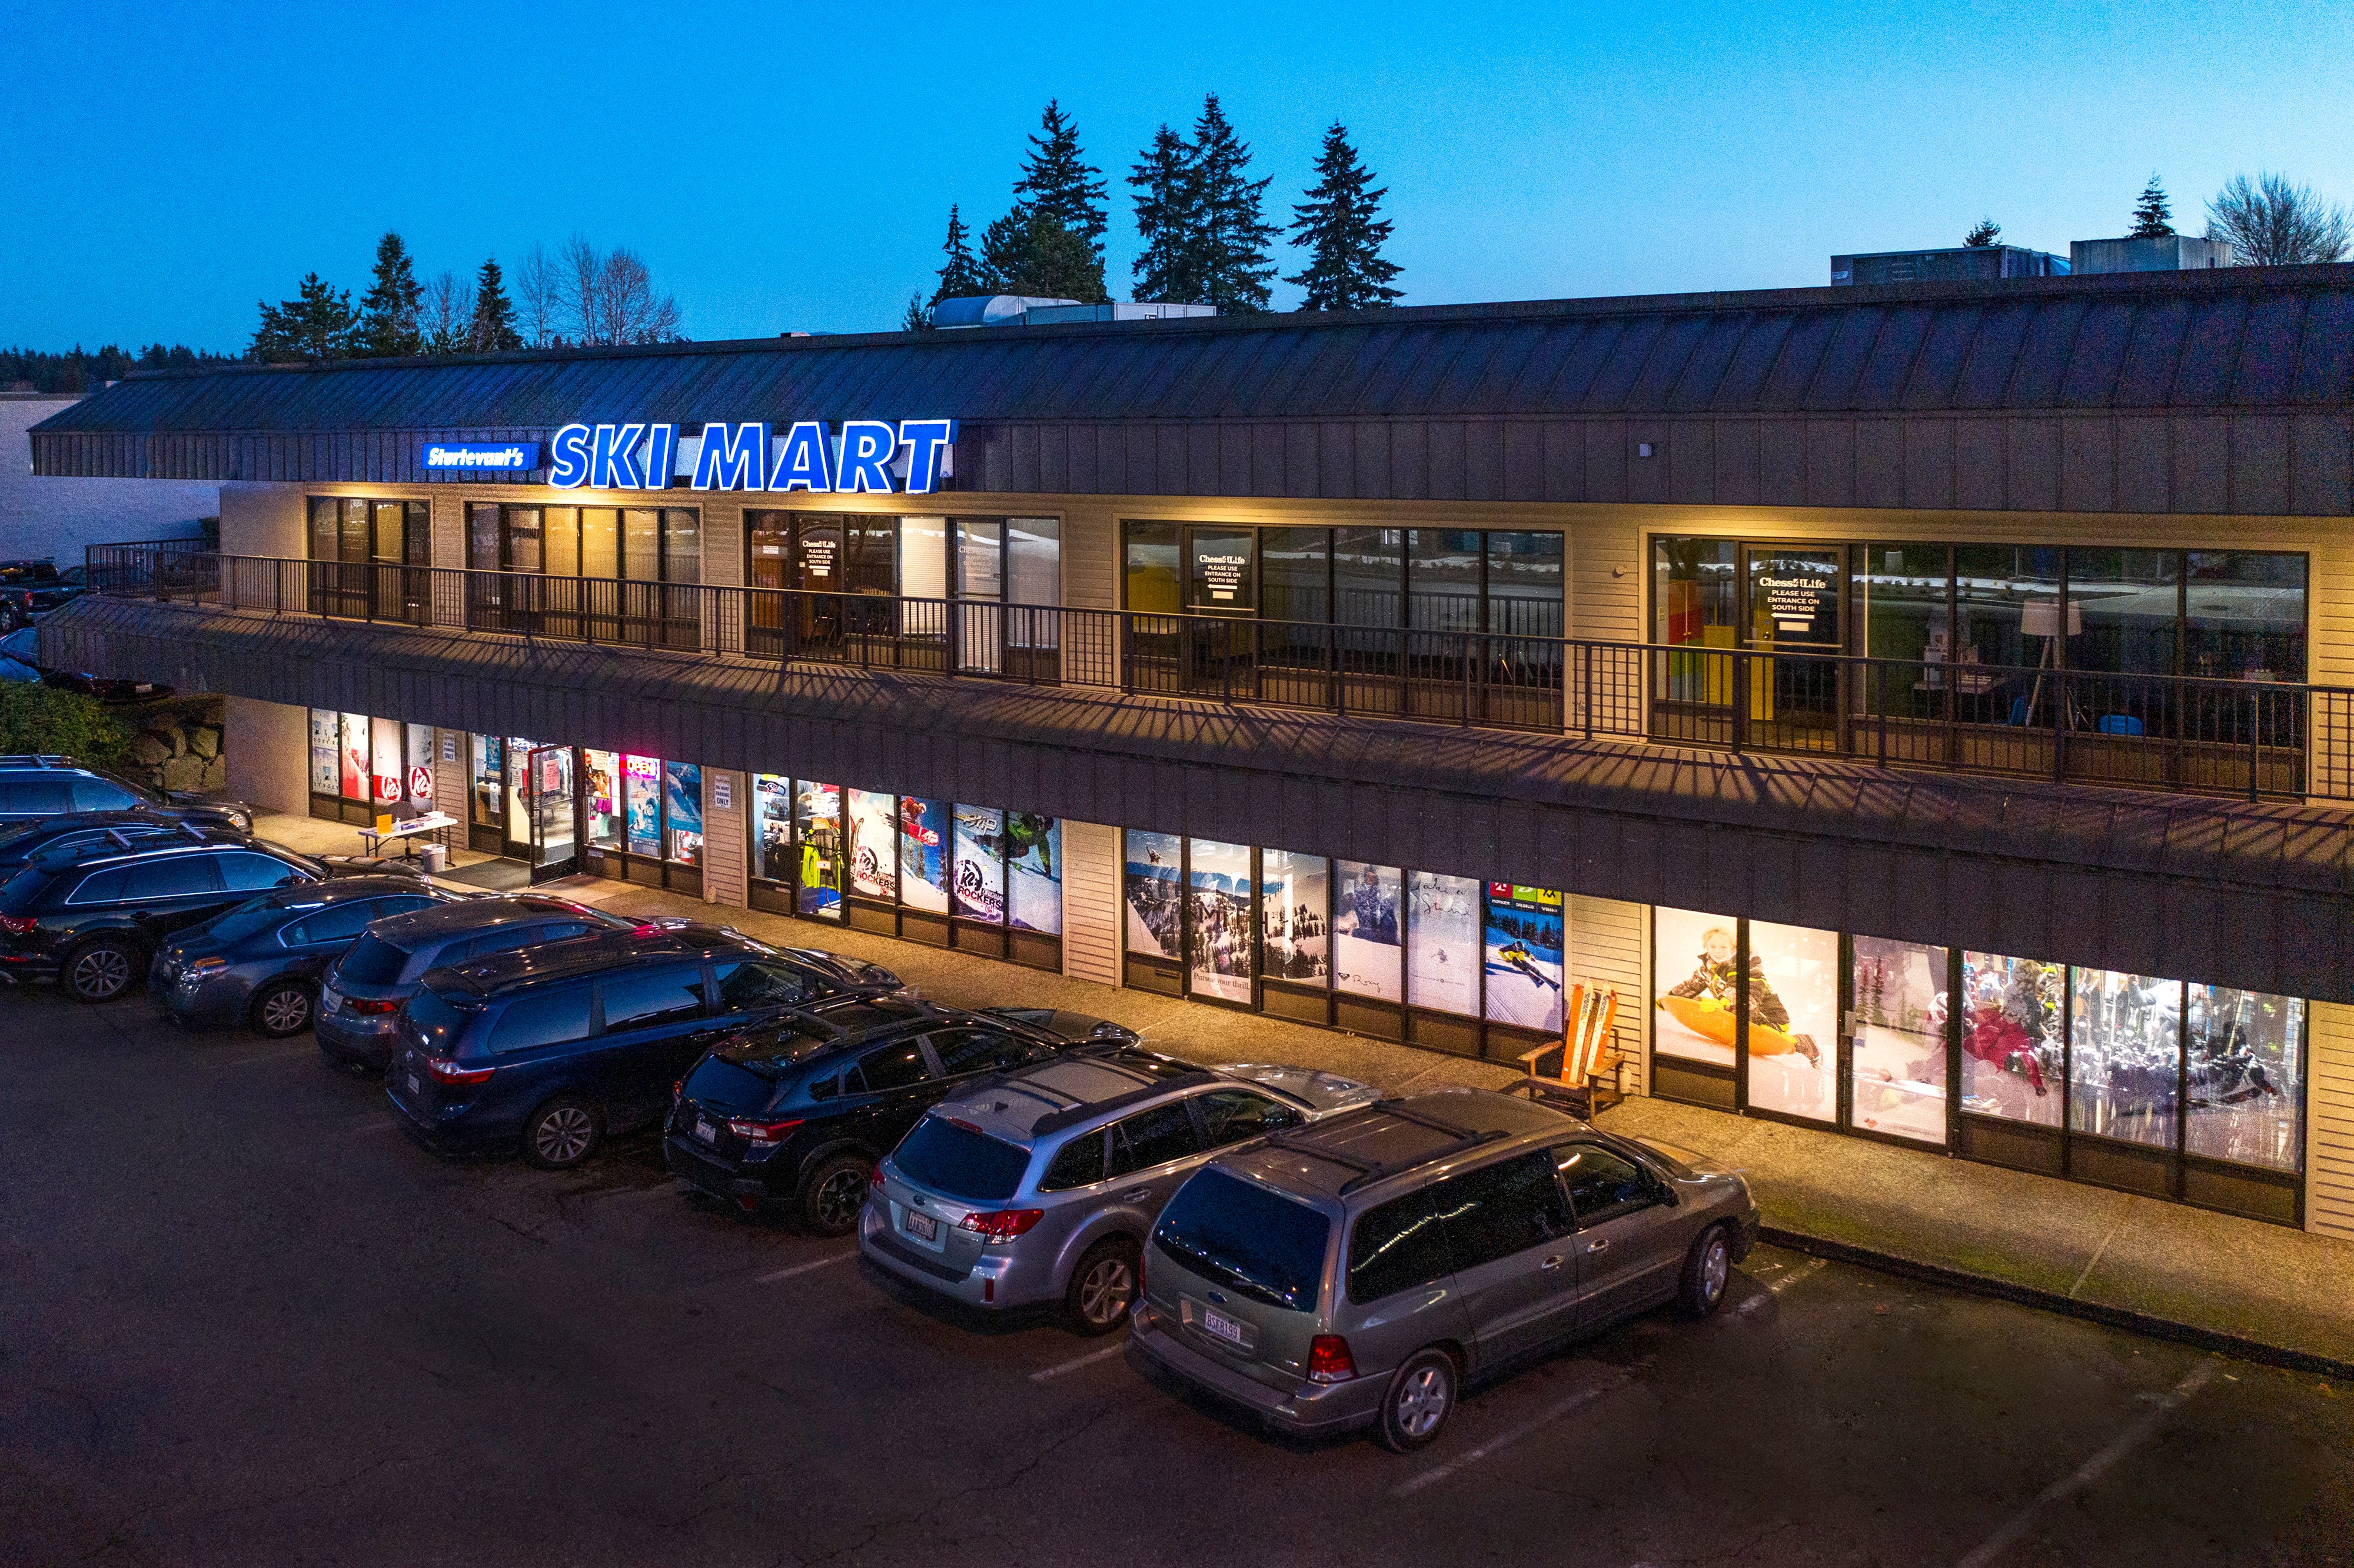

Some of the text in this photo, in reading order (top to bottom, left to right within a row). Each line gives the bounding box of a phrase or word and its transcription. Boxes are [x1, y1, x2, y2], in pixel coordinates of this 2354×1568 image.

[428, 447, 523, 467] Sturtevant's
[548, 420, 951, 494] SKI MART
[627, 760, 653, 775] OPEN
[716, 797, 729, 805] ONLY
[857, 870, 895, 891] ROCKERS
[877, 872, 895, 883] ORIGINA
[958, 884, 1003, 909] ROCKERS
[982, 889, 1003, 902] ORIGINA
[1206, 1313, 1238, 1339] BSF8199
